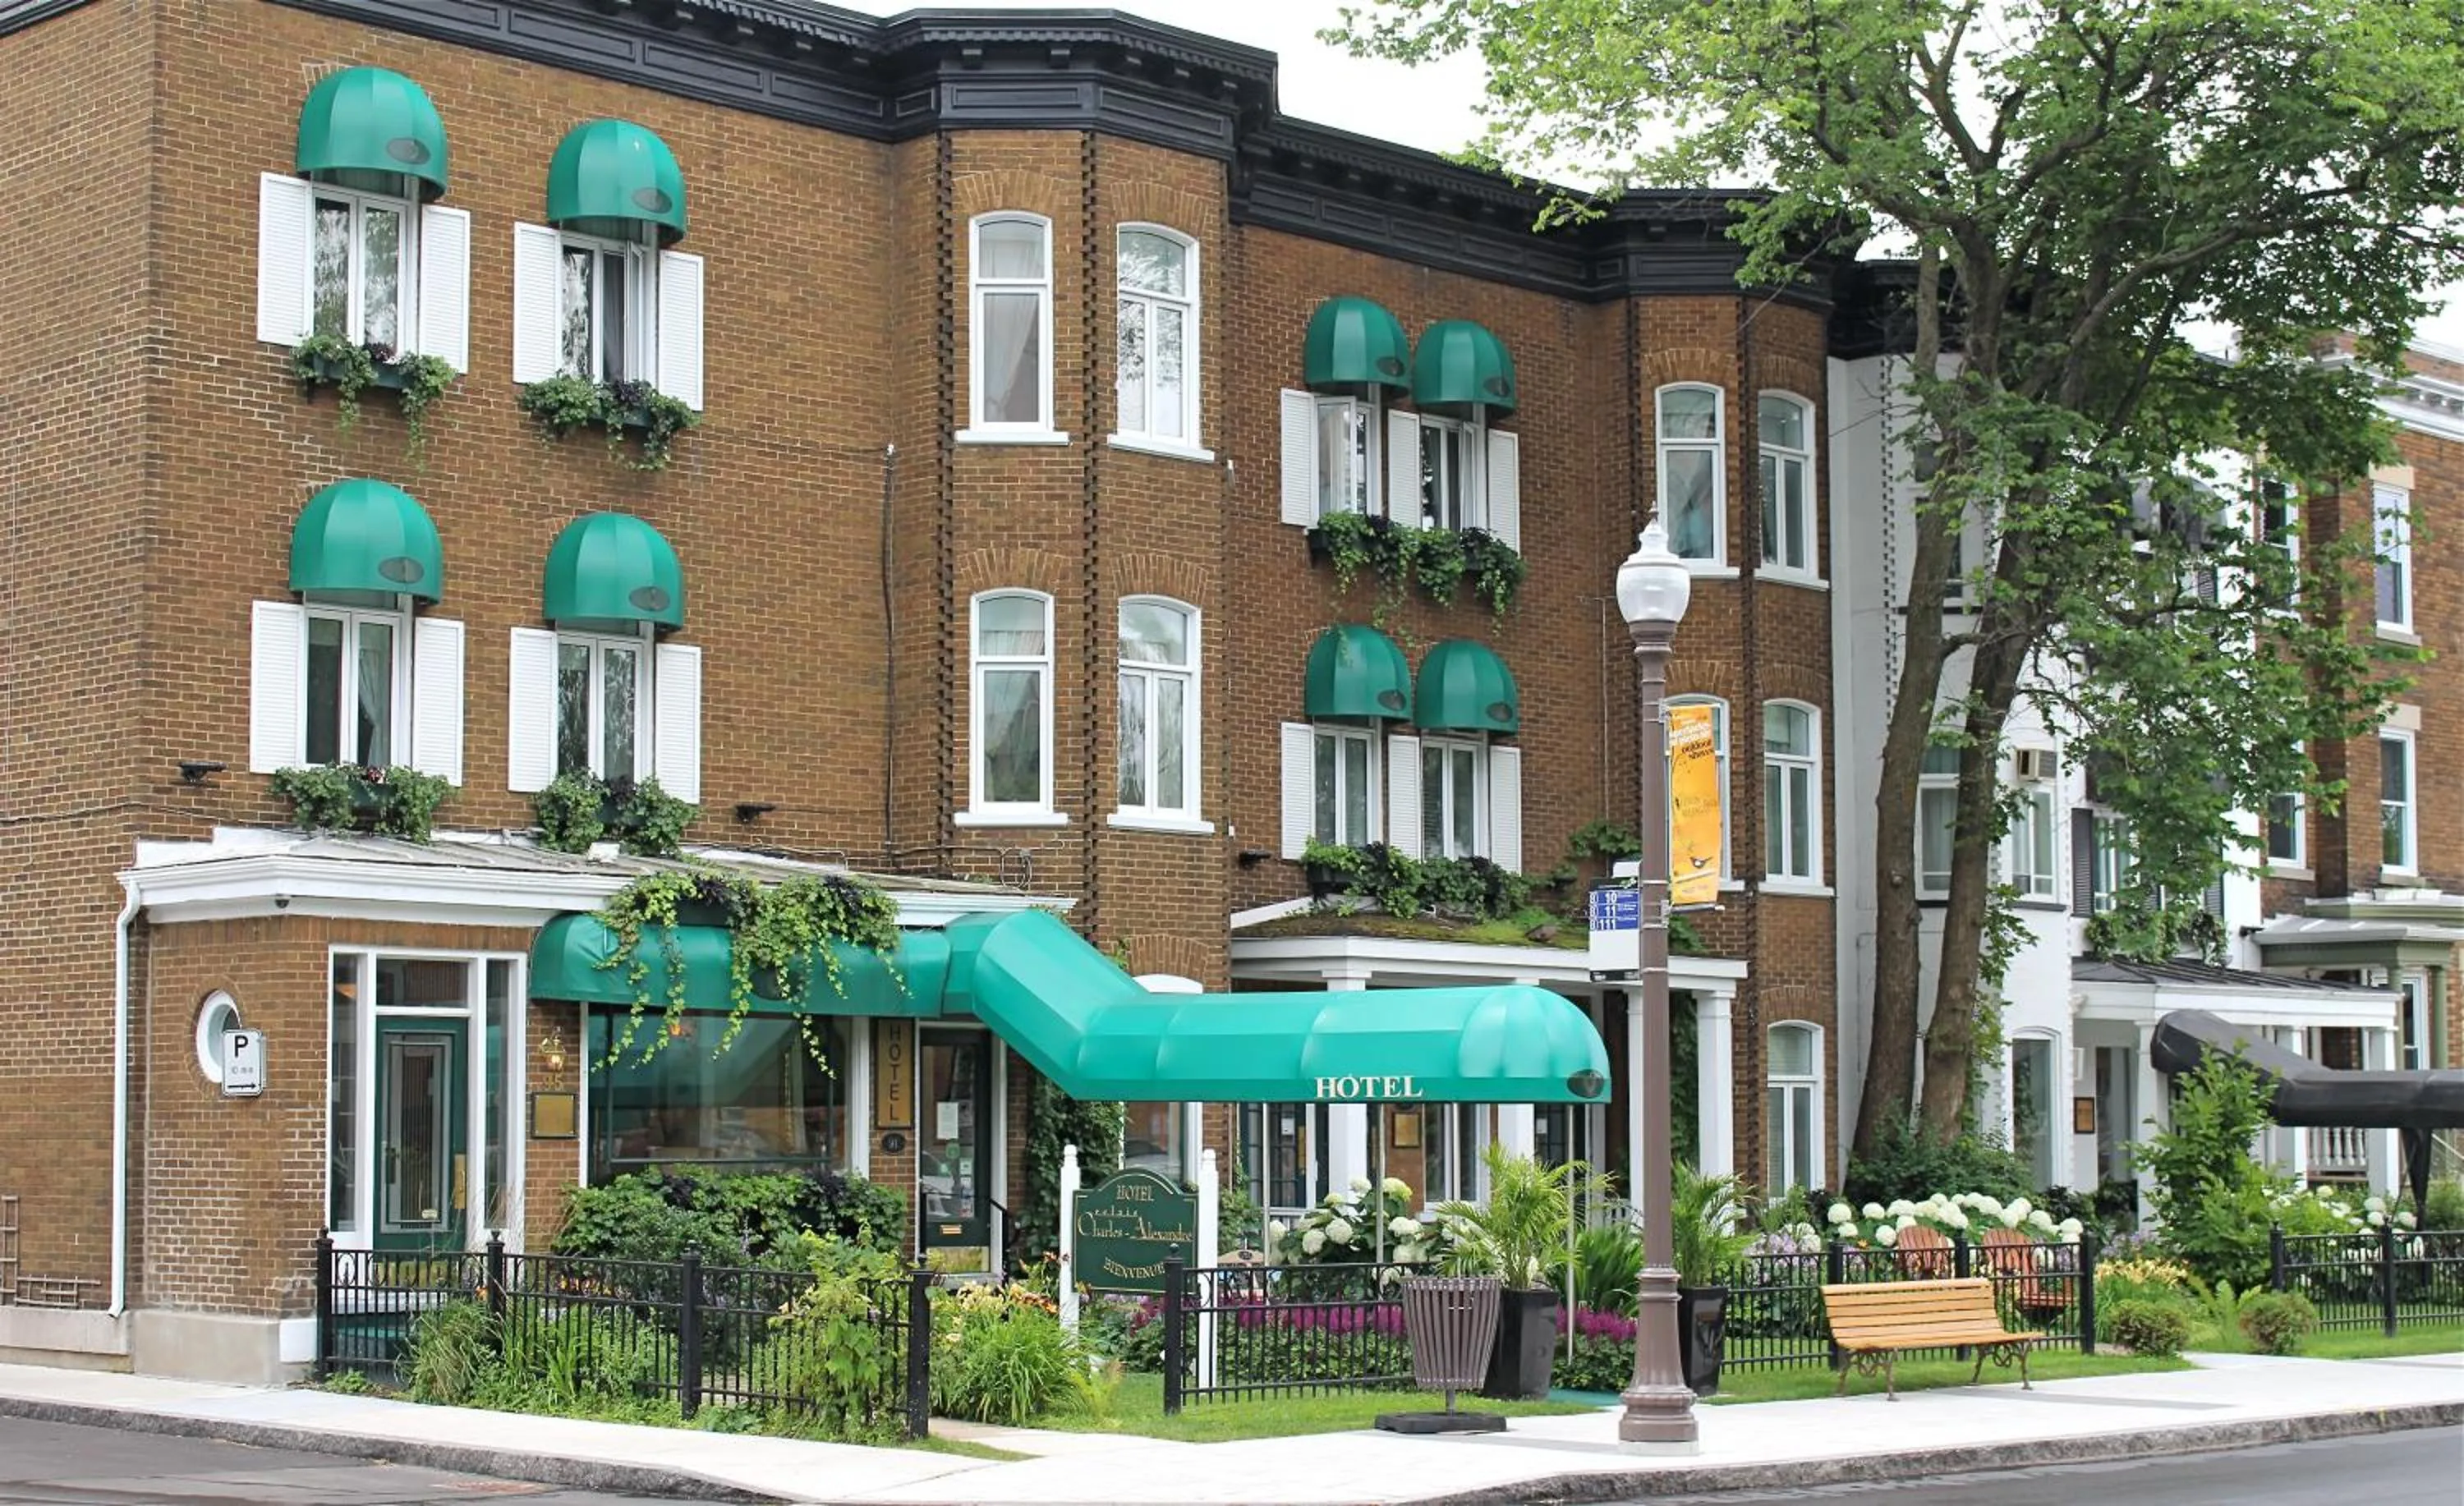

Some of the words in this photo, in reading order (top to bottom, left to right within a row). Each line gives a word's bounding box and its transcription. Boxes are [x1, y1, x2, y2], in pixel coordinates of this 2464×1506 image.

[1605, 893, 1617, 903] 10
[1604, 906, 1616, 916] 11
[234, 1035, 248, 1058] P
[890, 1023, 902, 1121] HOTEL
